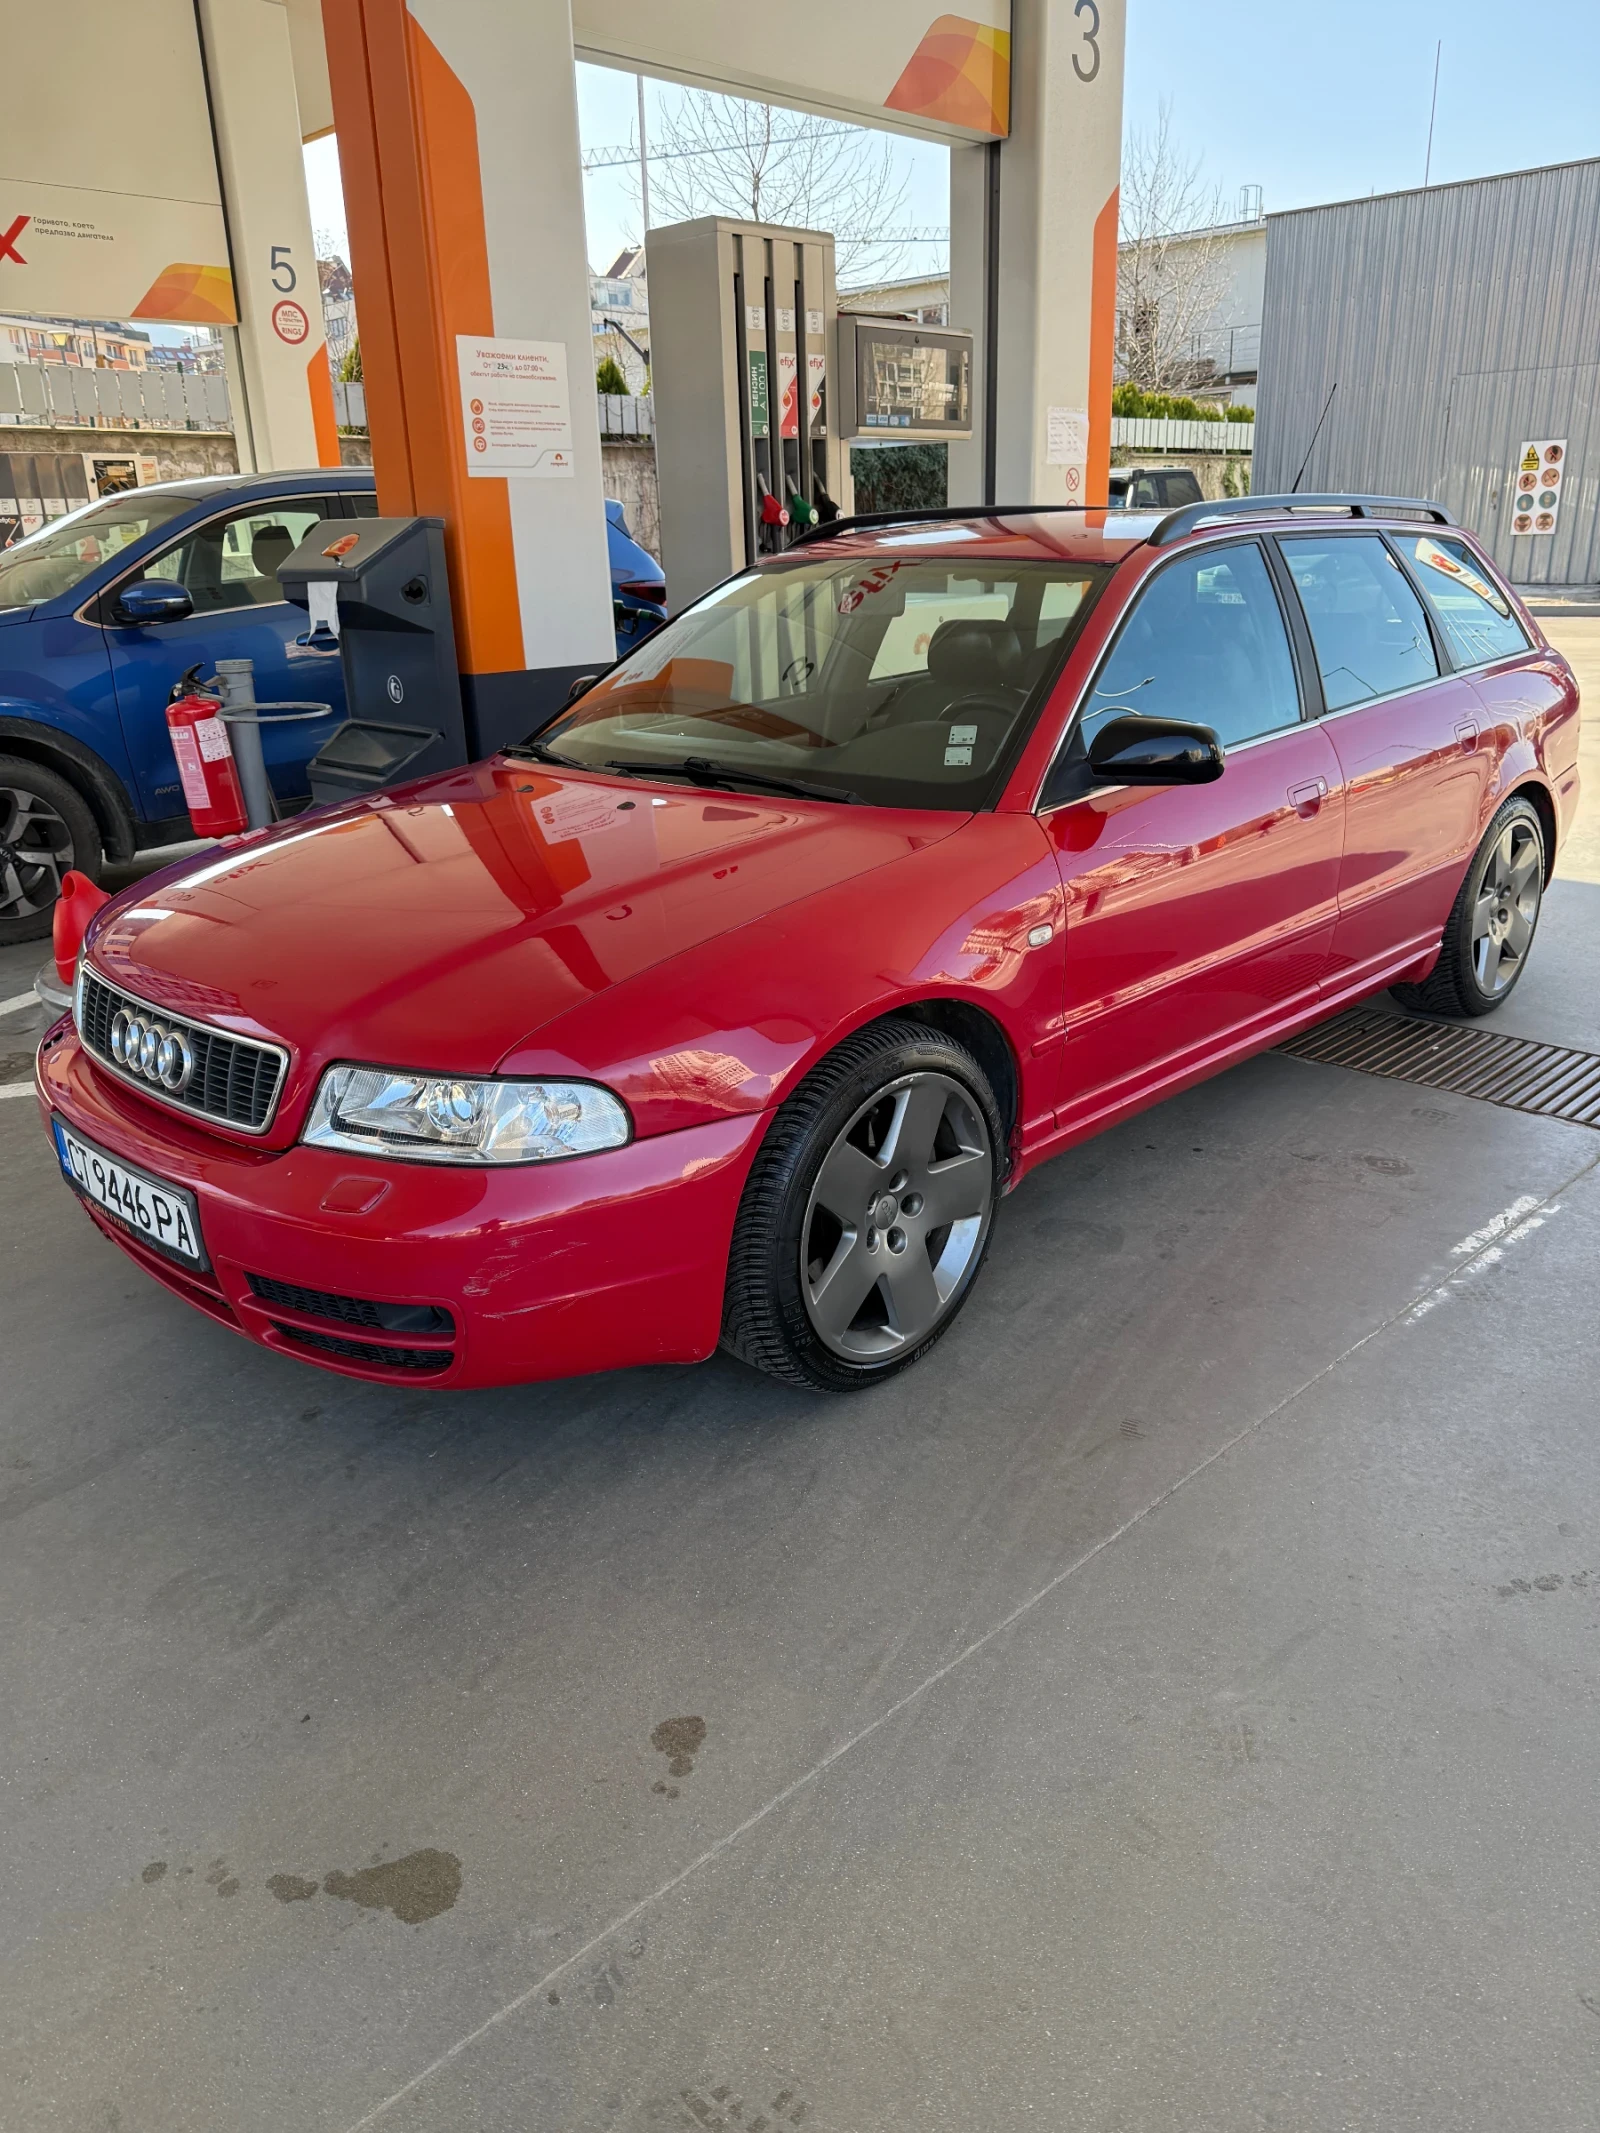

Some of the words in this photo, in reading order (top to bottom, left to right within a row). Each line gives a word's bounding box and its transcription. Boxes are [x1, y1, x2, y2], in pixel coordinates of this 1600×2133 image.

[1072, 0, 1100, 82] 3
[271, 246, 296, 293] 5
[281, 310, 298, 318] МПС
[281, 327, 302, 335] RINGS
[476, 350, 517, 360] Уважаеми
[517, 354, 550, 363] клиенти,
[780, 357, 795, 368] efix
[809, 358, 824, 370] efix
[751, 366, 759, 407] БЕНЗИН
[758, 376, 766, 395] 100
[155, 785, 180, 796] AWD
